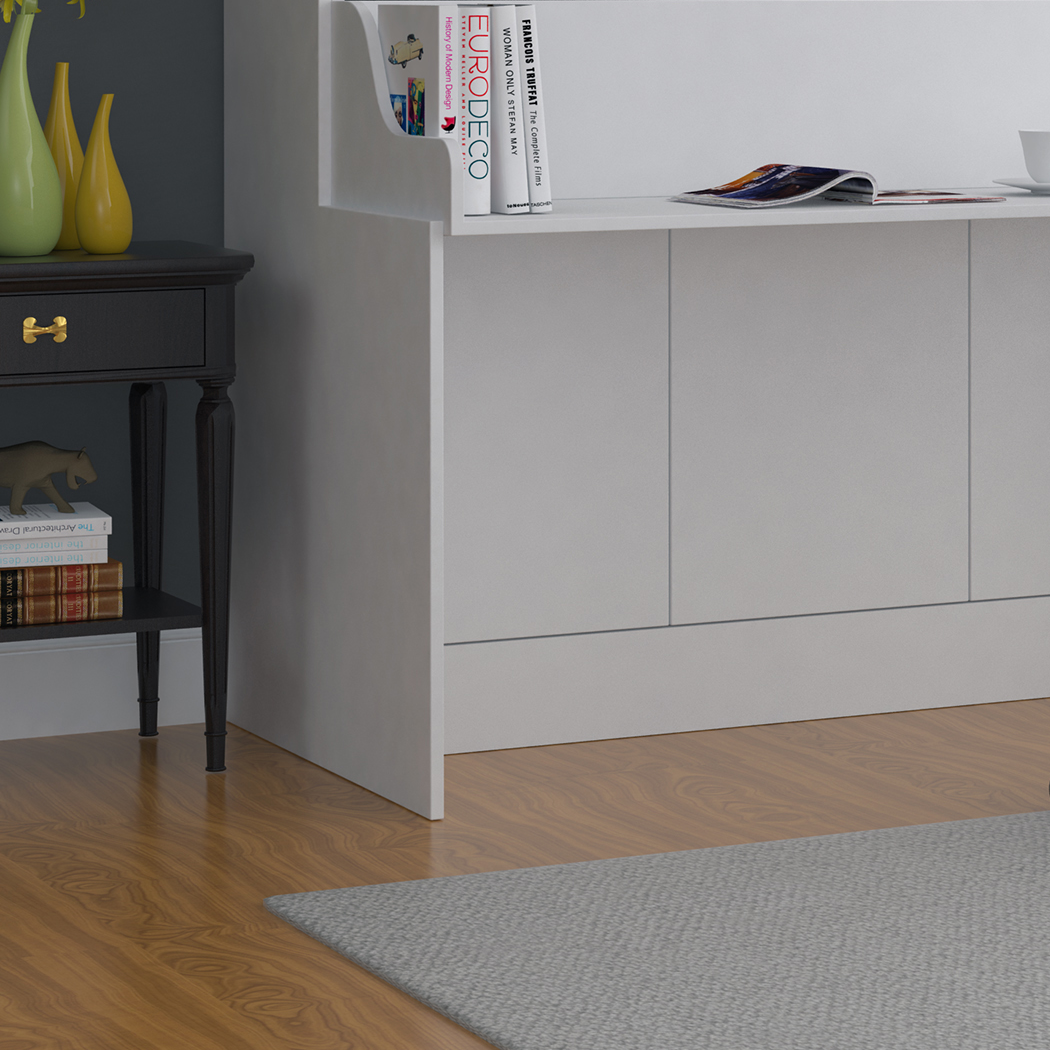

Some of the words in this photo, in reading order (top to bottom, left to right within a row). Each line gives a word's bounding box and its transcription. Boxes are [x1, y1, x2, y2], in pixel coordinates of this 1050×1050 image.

[444, 16, 452, 42] History
[522, 19, 534, 64] FRANCOIS
[503, 27, 513, 67] WOMAN
[506, 70, 515, 96] ONLY
[526, 68, 538, 106] TRUFFAT
[444, 84, 452, 110] Design
[468, 15, 489, 180] EURODECO
[531, 127, 539, 163] Complete
[23, 524, 76, 534] Architectural
[24, 541, 63, 550] interior
[24, 555, 63, 564] interior
